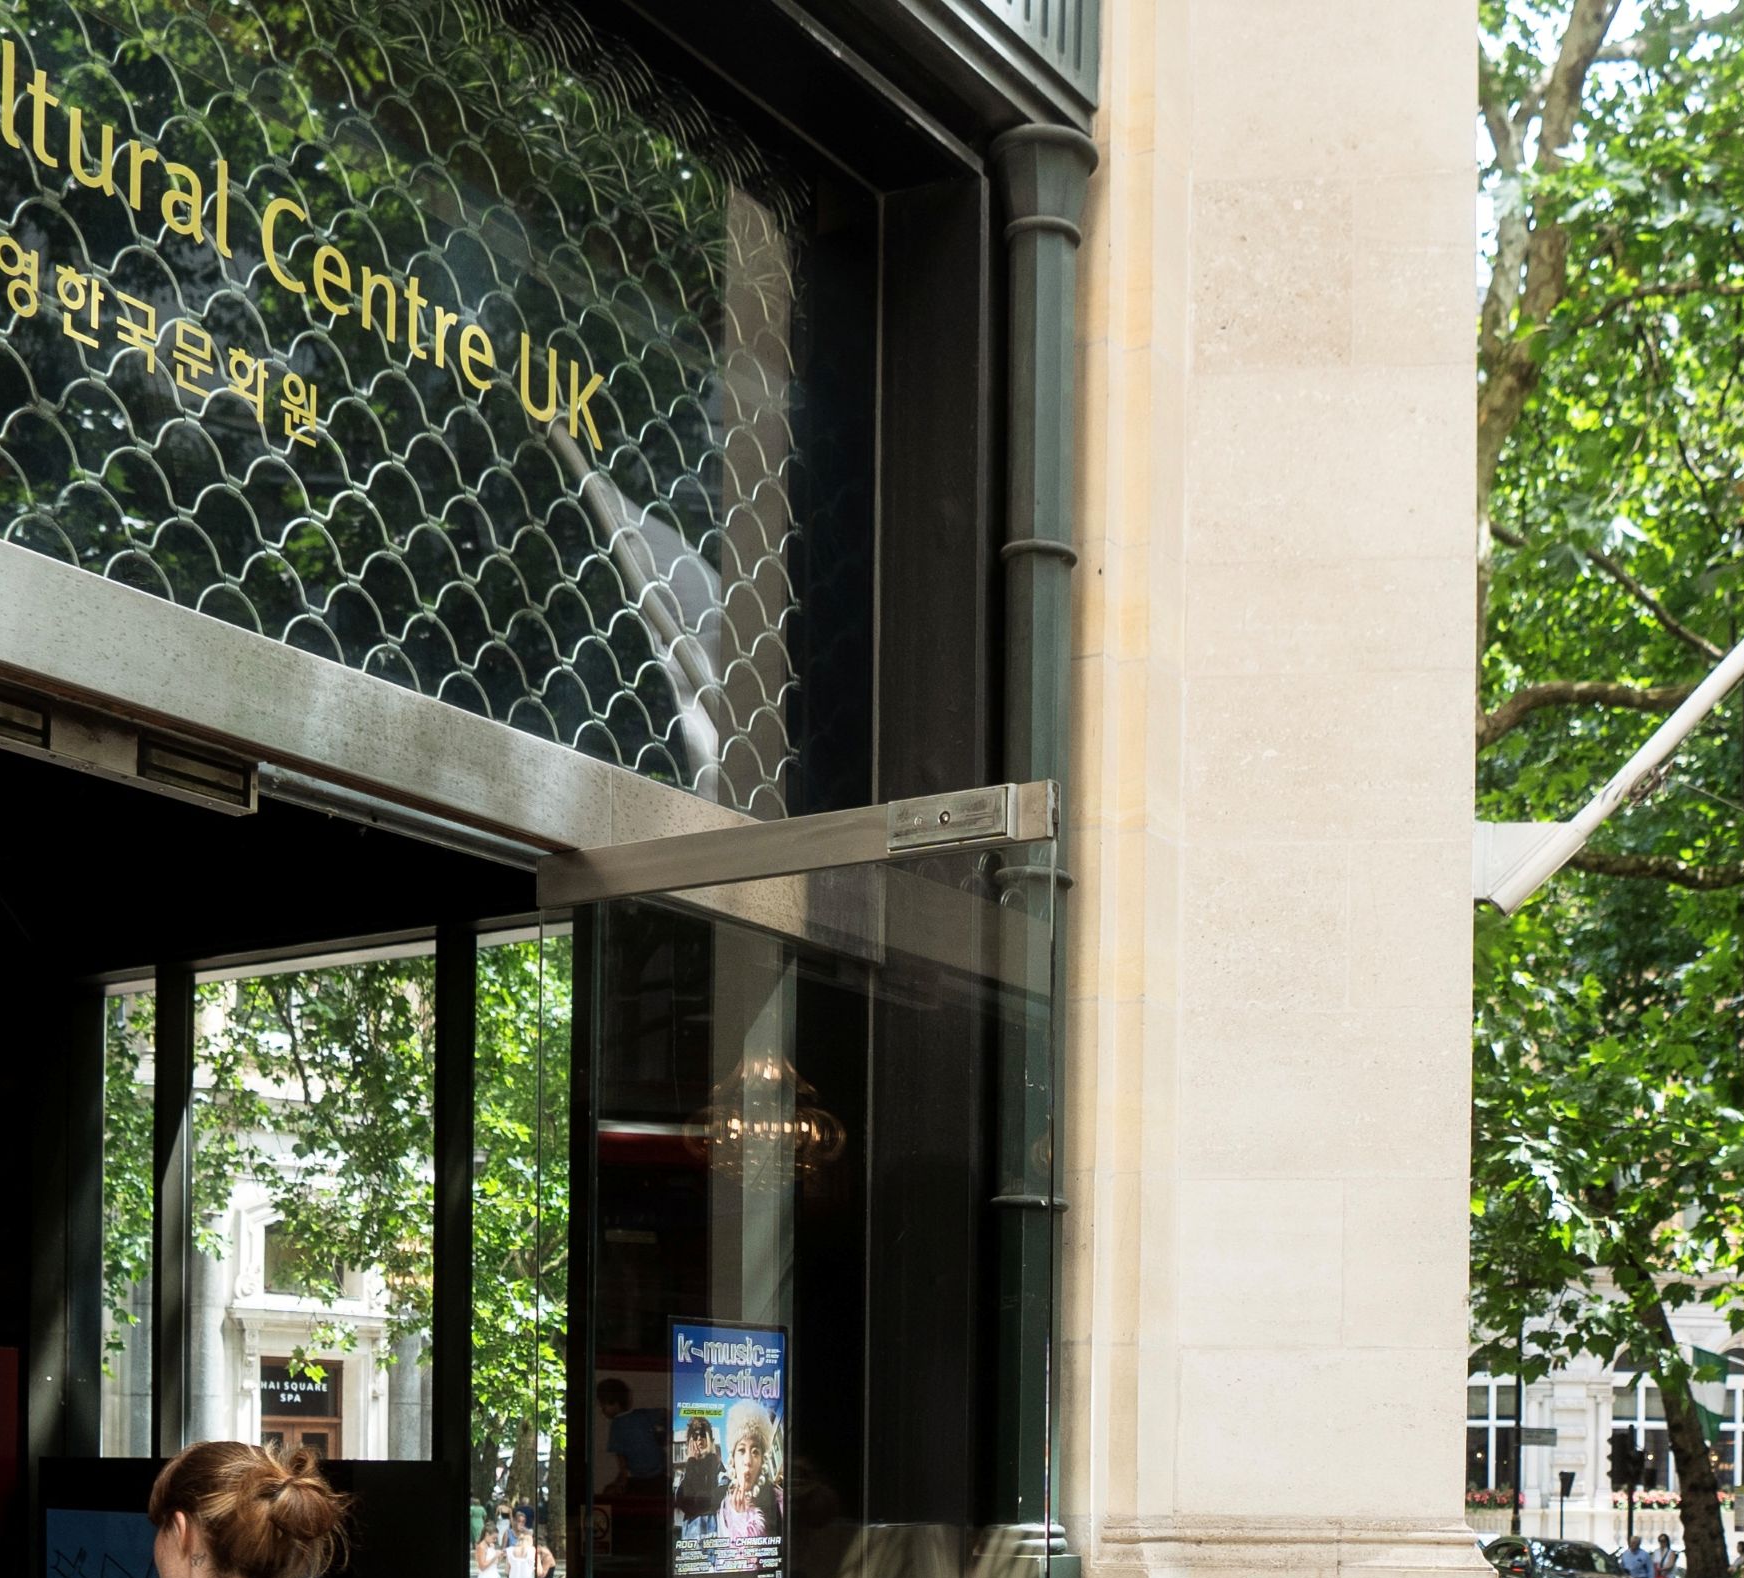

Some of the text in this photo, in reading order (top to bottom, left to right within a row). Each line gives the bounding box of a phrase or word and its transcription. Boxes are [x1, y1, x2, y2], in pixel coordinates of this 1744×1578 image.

[261, 197, 494, 391] Centre
[519, 333, 605, 450] UK
[677, 1333, 765, 1367] k-music
[261, 1381, 328, 1392] HAI SQUARE
[280, 1393, 301, 1402] SPA
[704, 1366, 781, 1399] festival
